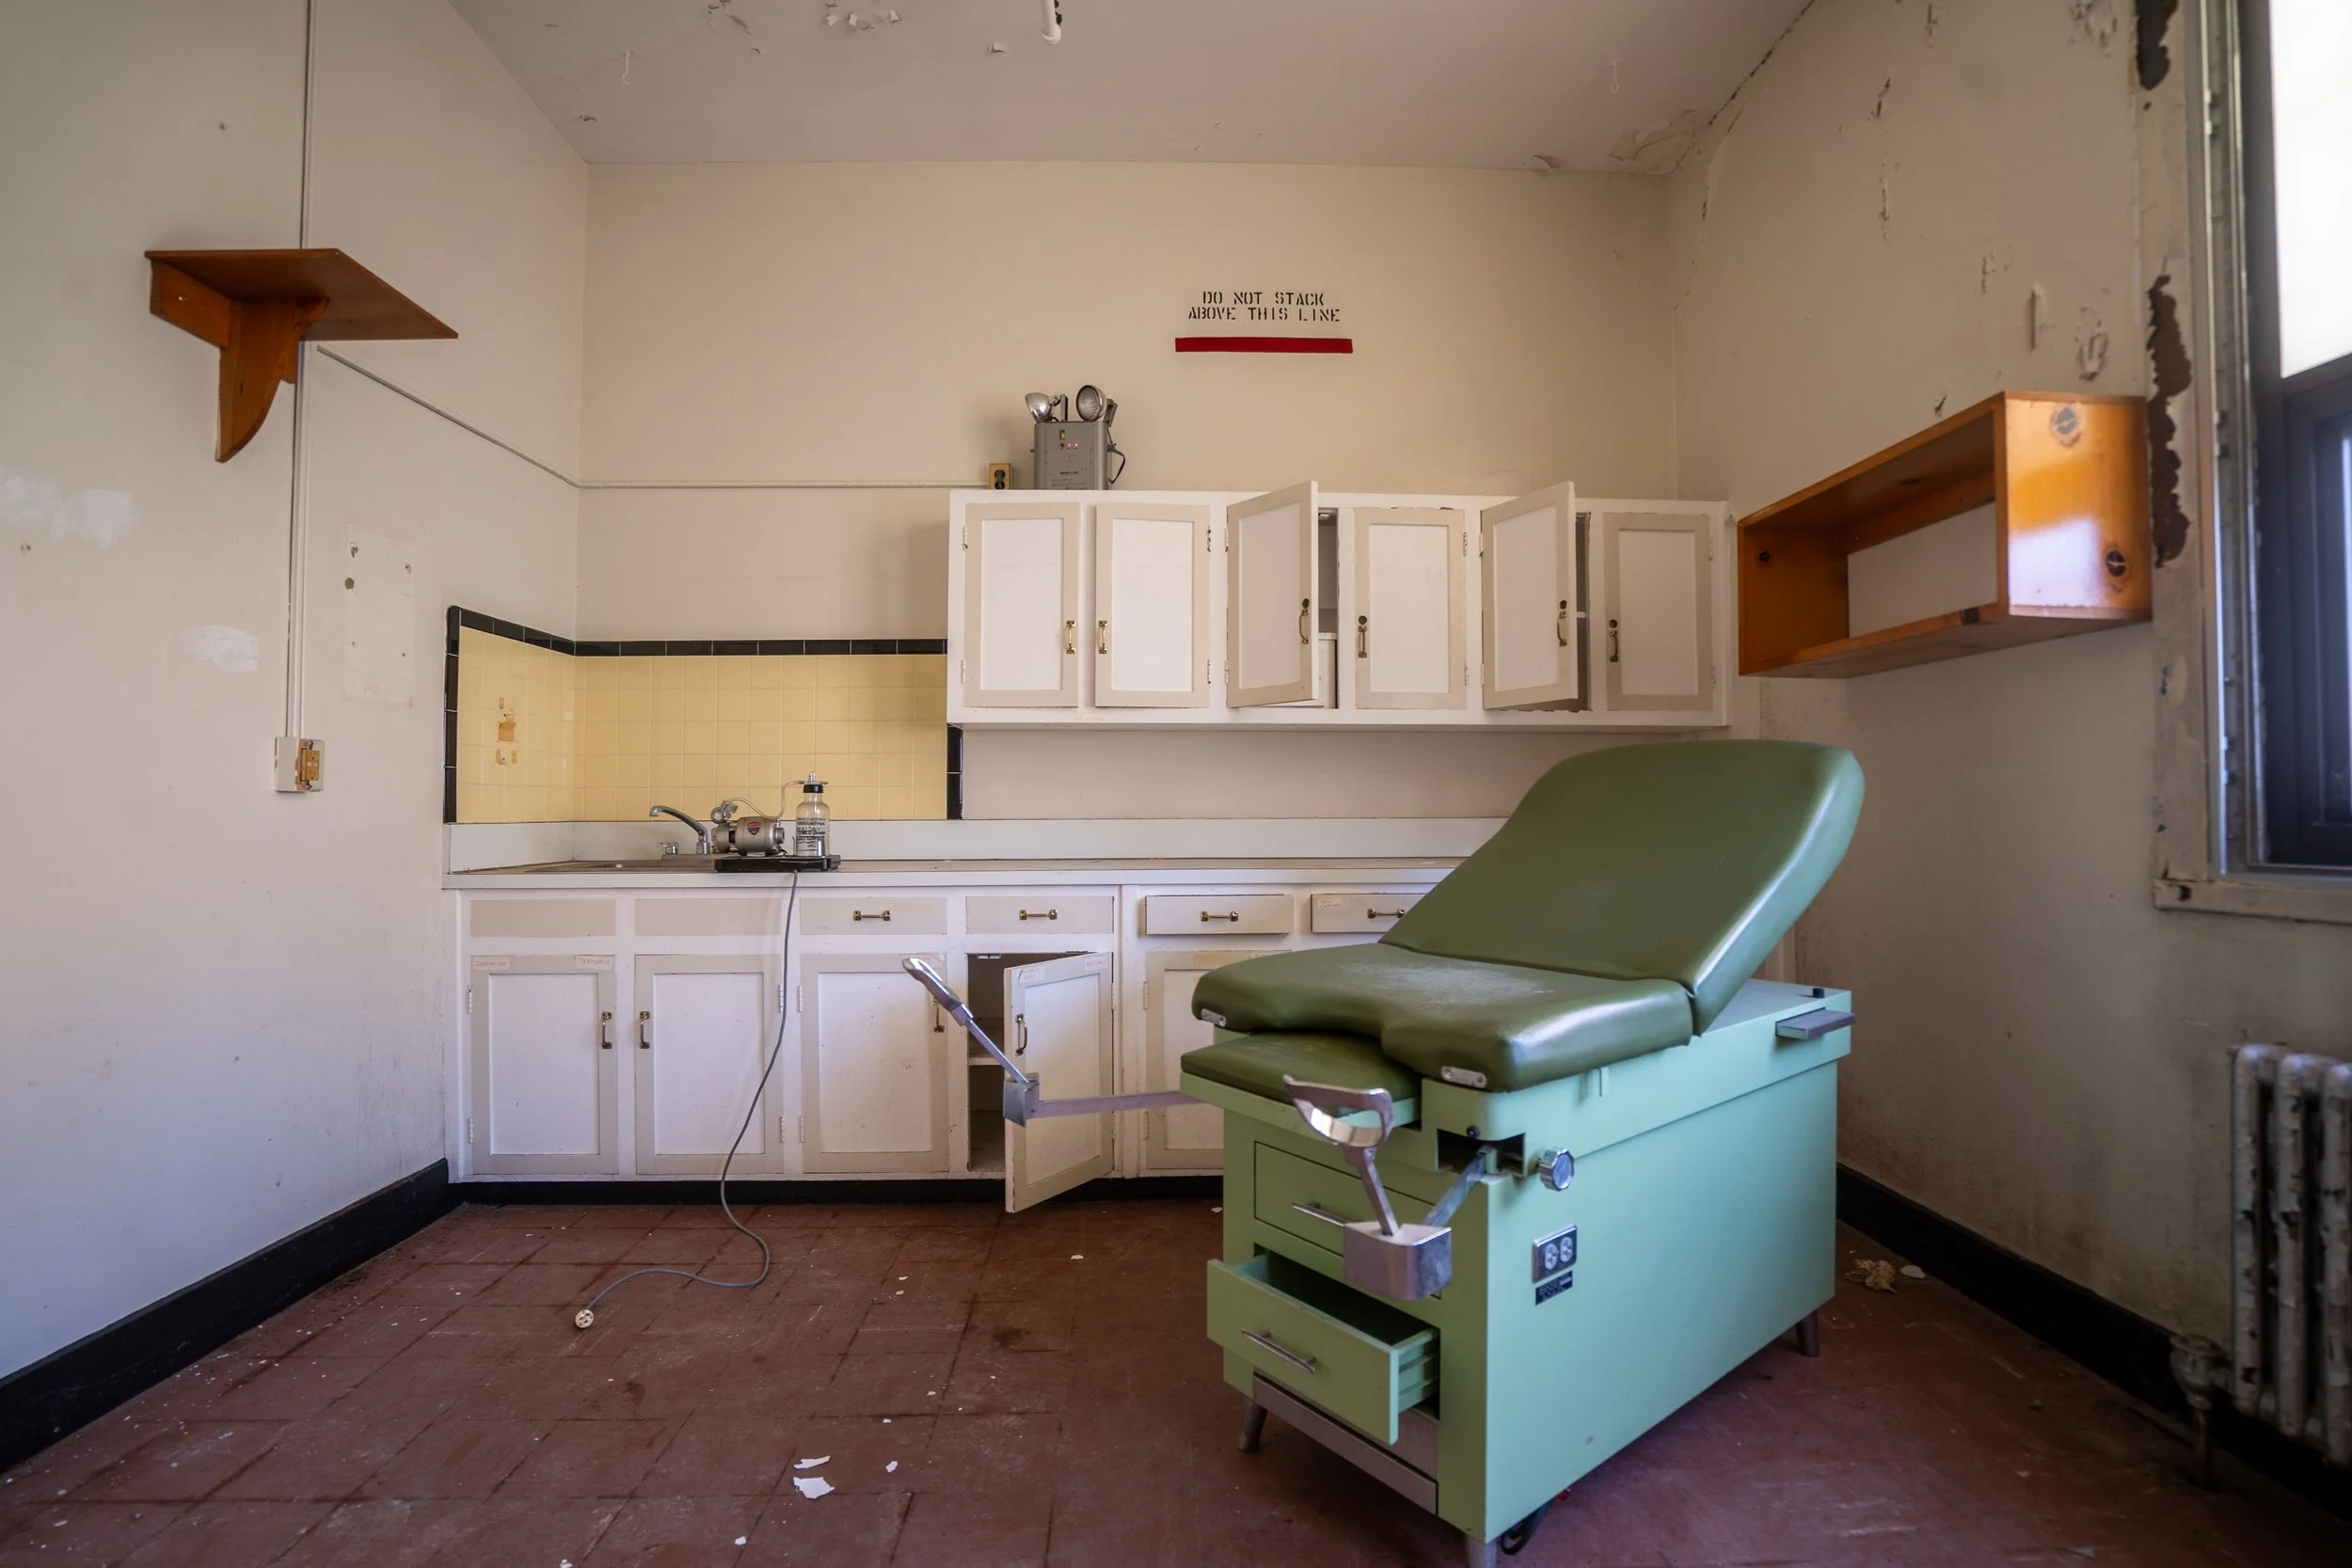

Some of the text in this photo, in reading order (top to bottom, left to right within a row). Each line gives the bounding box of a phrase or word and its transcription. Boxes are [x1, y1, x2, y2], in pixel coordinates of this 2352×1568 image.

[1202, 291, 1325, 307] DO NOT STACK
[1188, 307, 1341, 322] ABOVE THIS LINE
